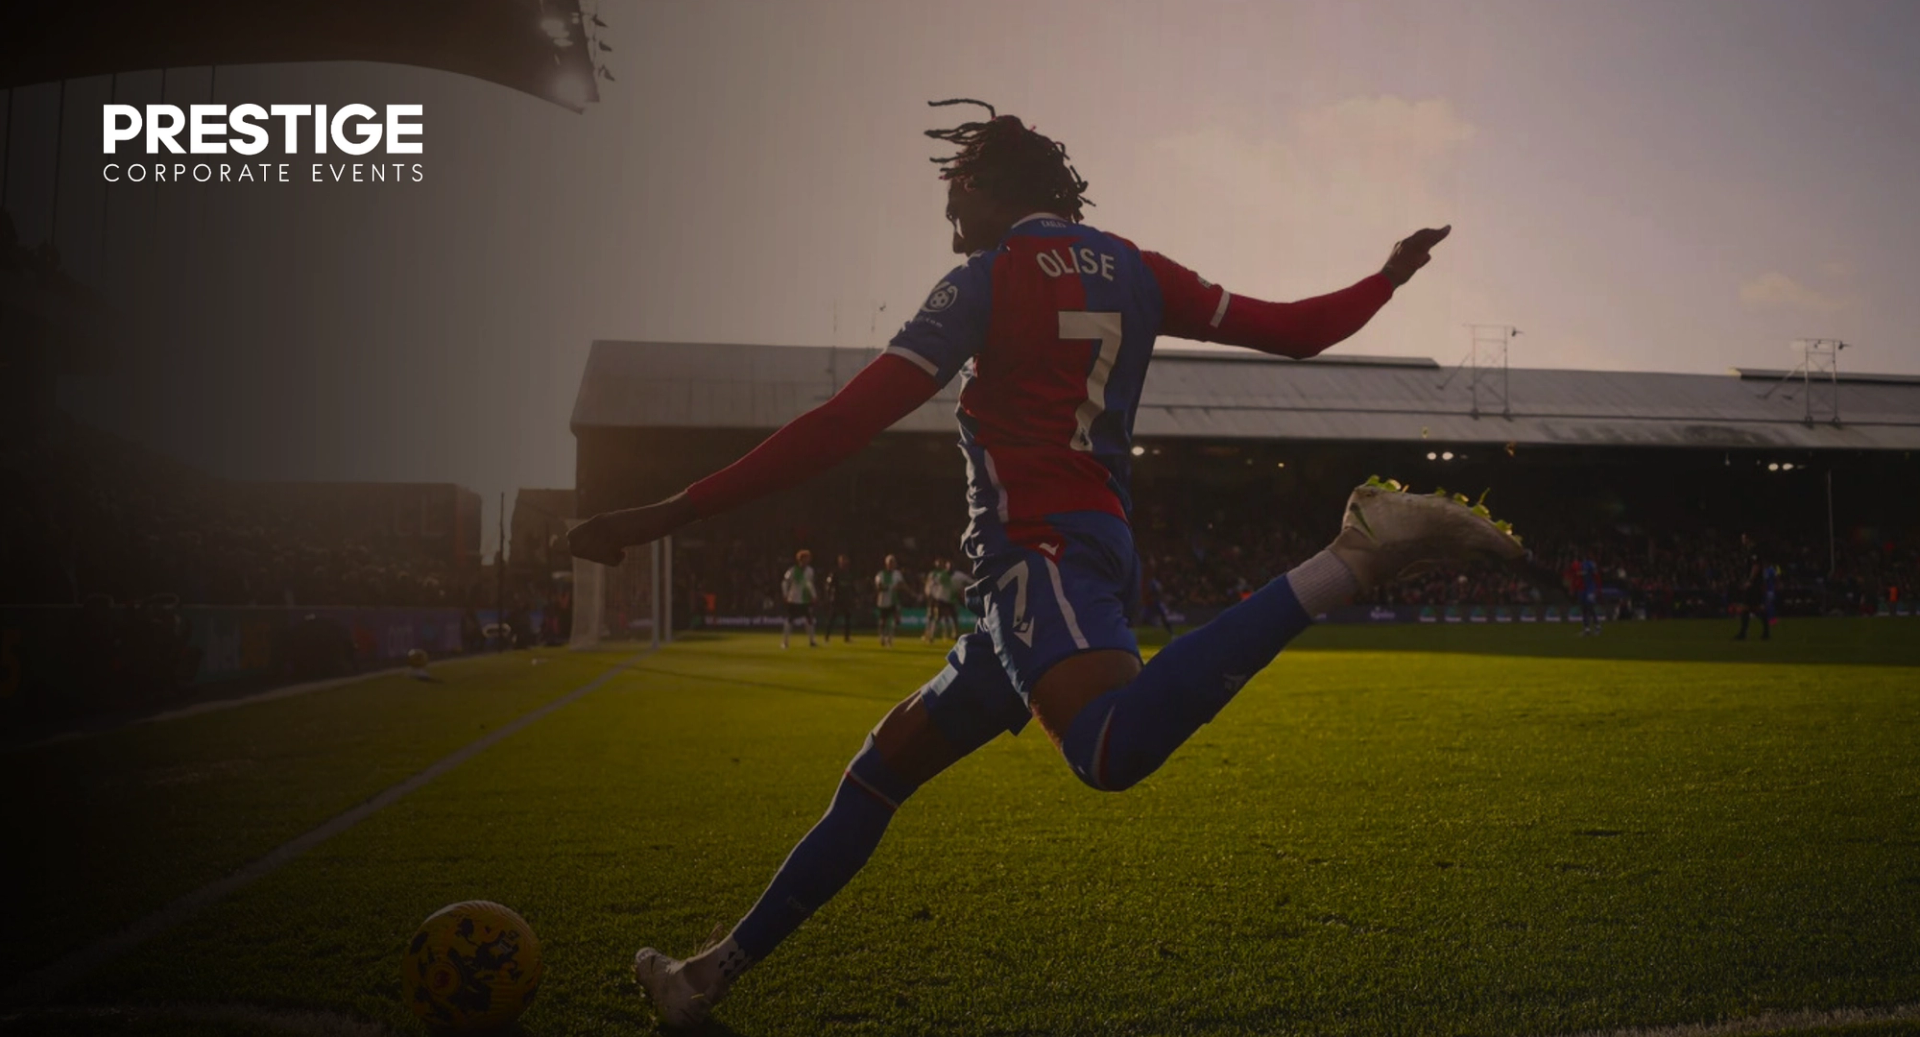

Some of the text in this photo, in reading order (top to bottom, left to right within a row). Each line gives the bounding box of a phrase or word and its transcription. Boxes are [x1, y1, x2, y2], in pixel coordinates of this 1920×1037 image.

[1036, 247, 1115, 281] OLISE
[1058, 311, 1122, 451] 7
[997, 560, 1029, 628] 7
